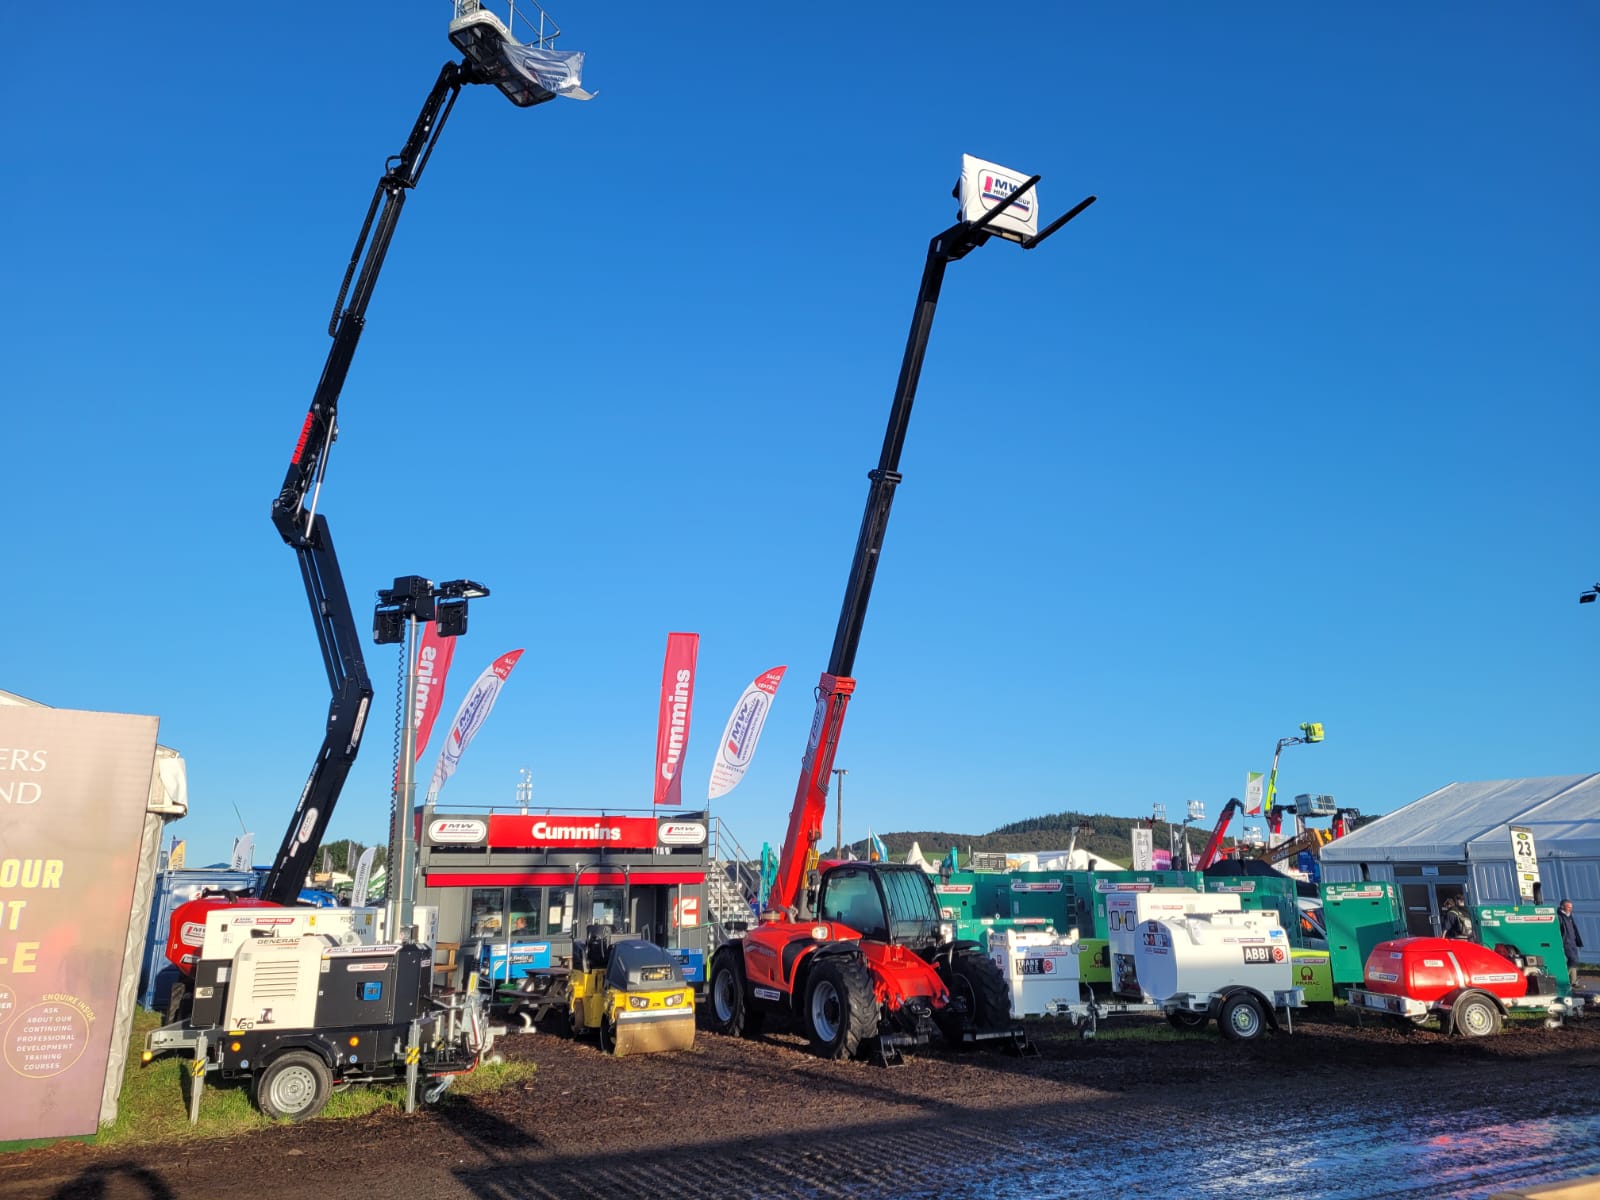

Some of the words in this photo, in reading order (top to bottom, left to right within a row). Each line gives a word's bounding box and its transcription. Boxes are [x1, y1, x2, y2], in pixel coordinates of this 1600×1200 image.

[662, 669, 690, 780] Cummins
[731, 702, 749, 740] MW
[531, 821, 622, 841] Cummins
[1517, 840, 1532, 857] 23
[1245, 947, 1270, 960] ABBI
[1016, 959, 1039, 967] TRANS
[42, 993, 79, 1004] ENQUIRE
[23, 1025, 72, 1033] CONTINUING
[16, 1034, 76, 1042] PROFESSIONAL
[16, 1043, 73, 1052] DEVELOPMENT
[25, 1053, 62, 1061] TRAINING
[23, 1062, 60, 1071] COURSES
